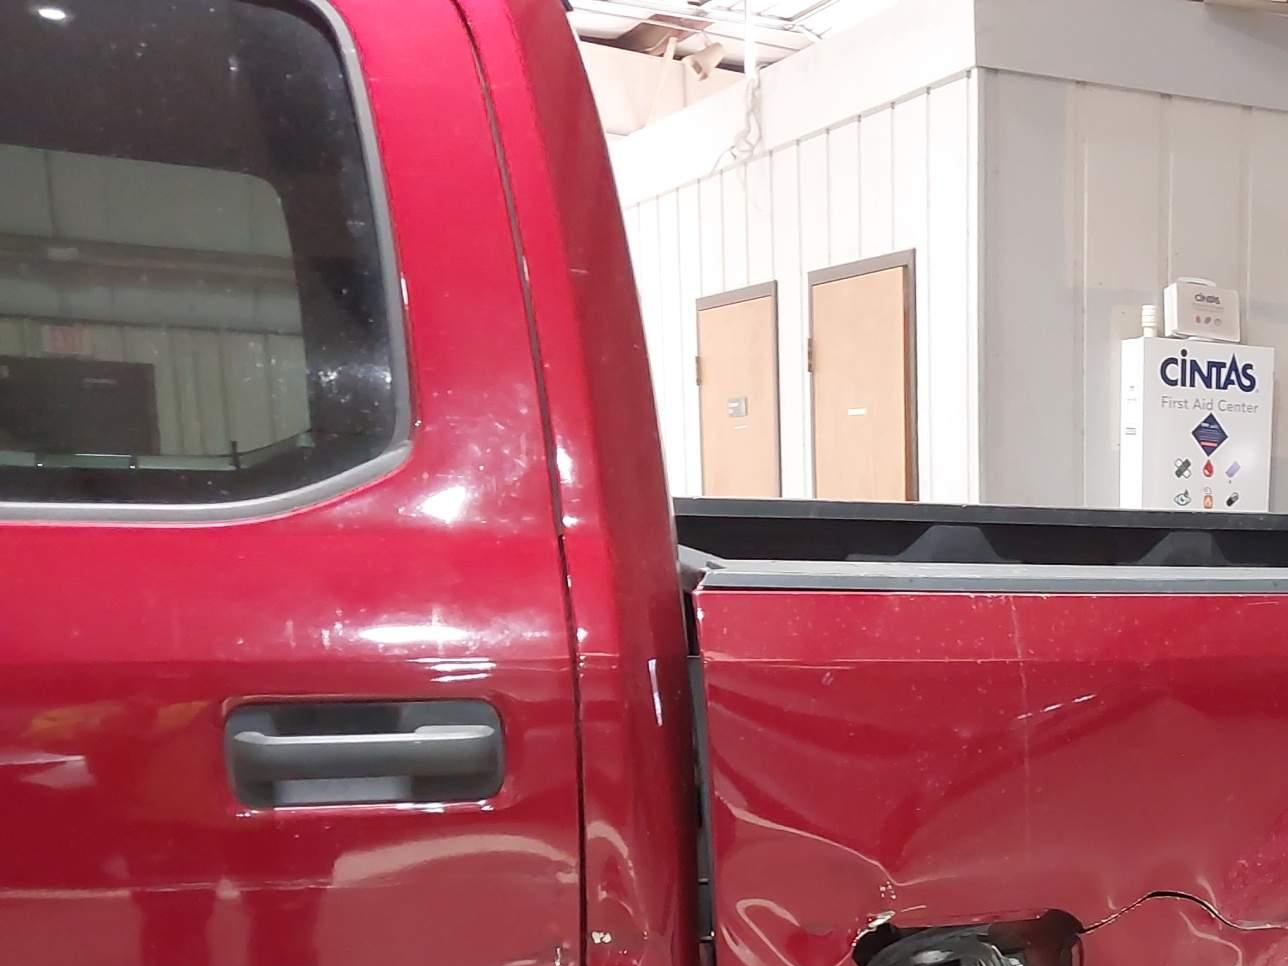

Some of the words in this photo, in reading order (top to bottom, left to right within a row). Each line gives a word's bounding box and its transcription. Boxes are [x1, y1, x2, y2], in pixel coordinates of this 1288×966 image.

[1161, 395, 1188, 409] First
[1192, 398, 1213, 411] Aid
[1217, 399, 1259, 413] Center
